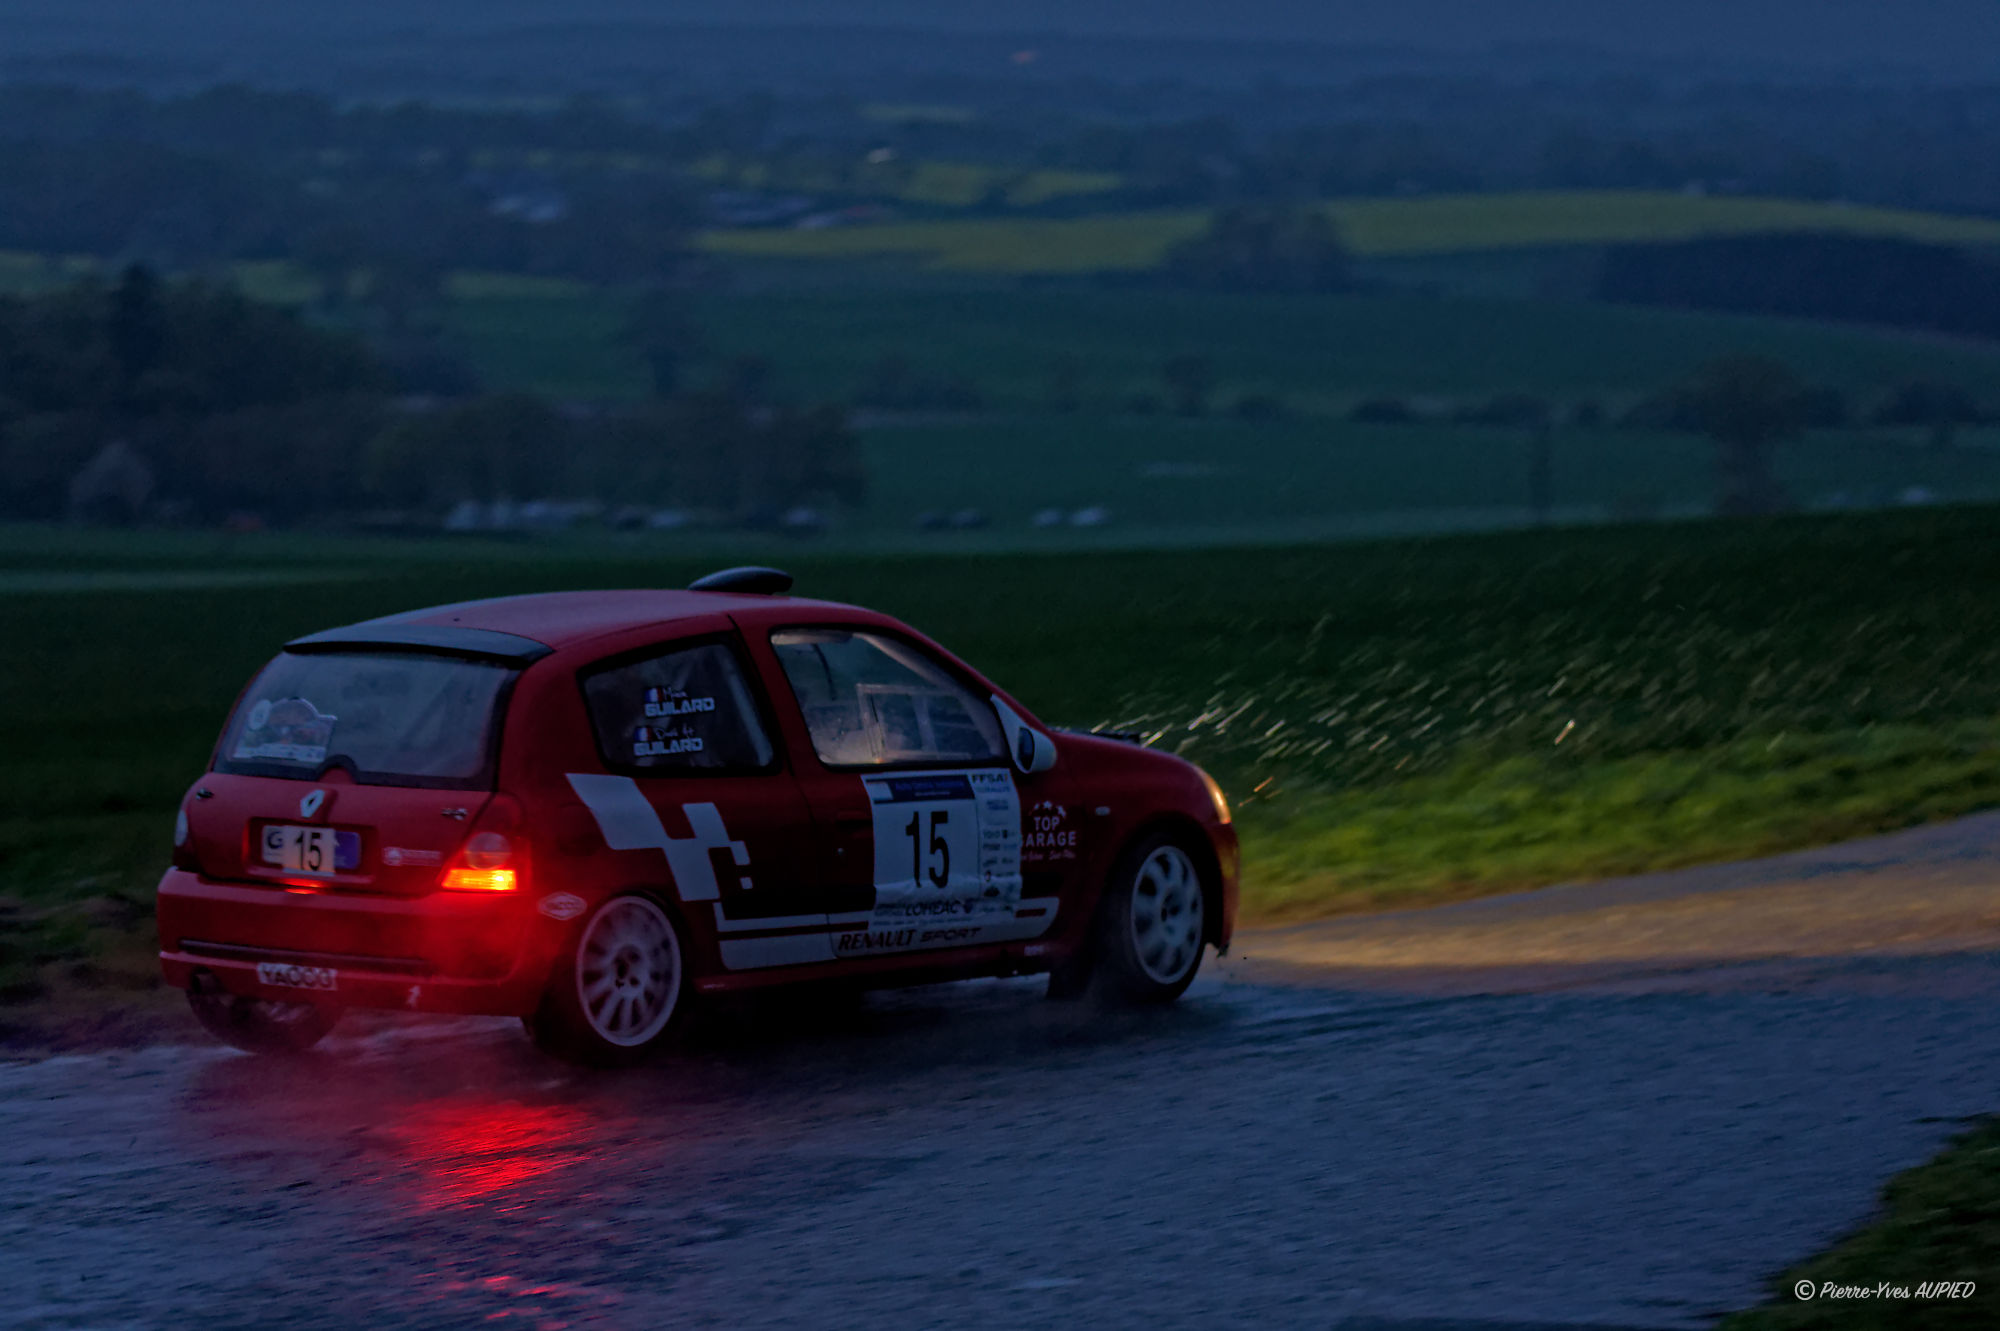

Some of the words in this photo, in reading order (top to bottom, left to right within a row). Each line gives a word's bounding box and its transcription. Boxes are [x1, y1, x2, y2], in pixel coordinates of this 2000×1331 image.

[1033, 815, 1060, 832] TOP
[295, 830, 322, 871] 15
[906, 811, 950, 889] 15
[838, 929, 917, 951] RENAULT
[920, 927, 982, 943] SPORT
